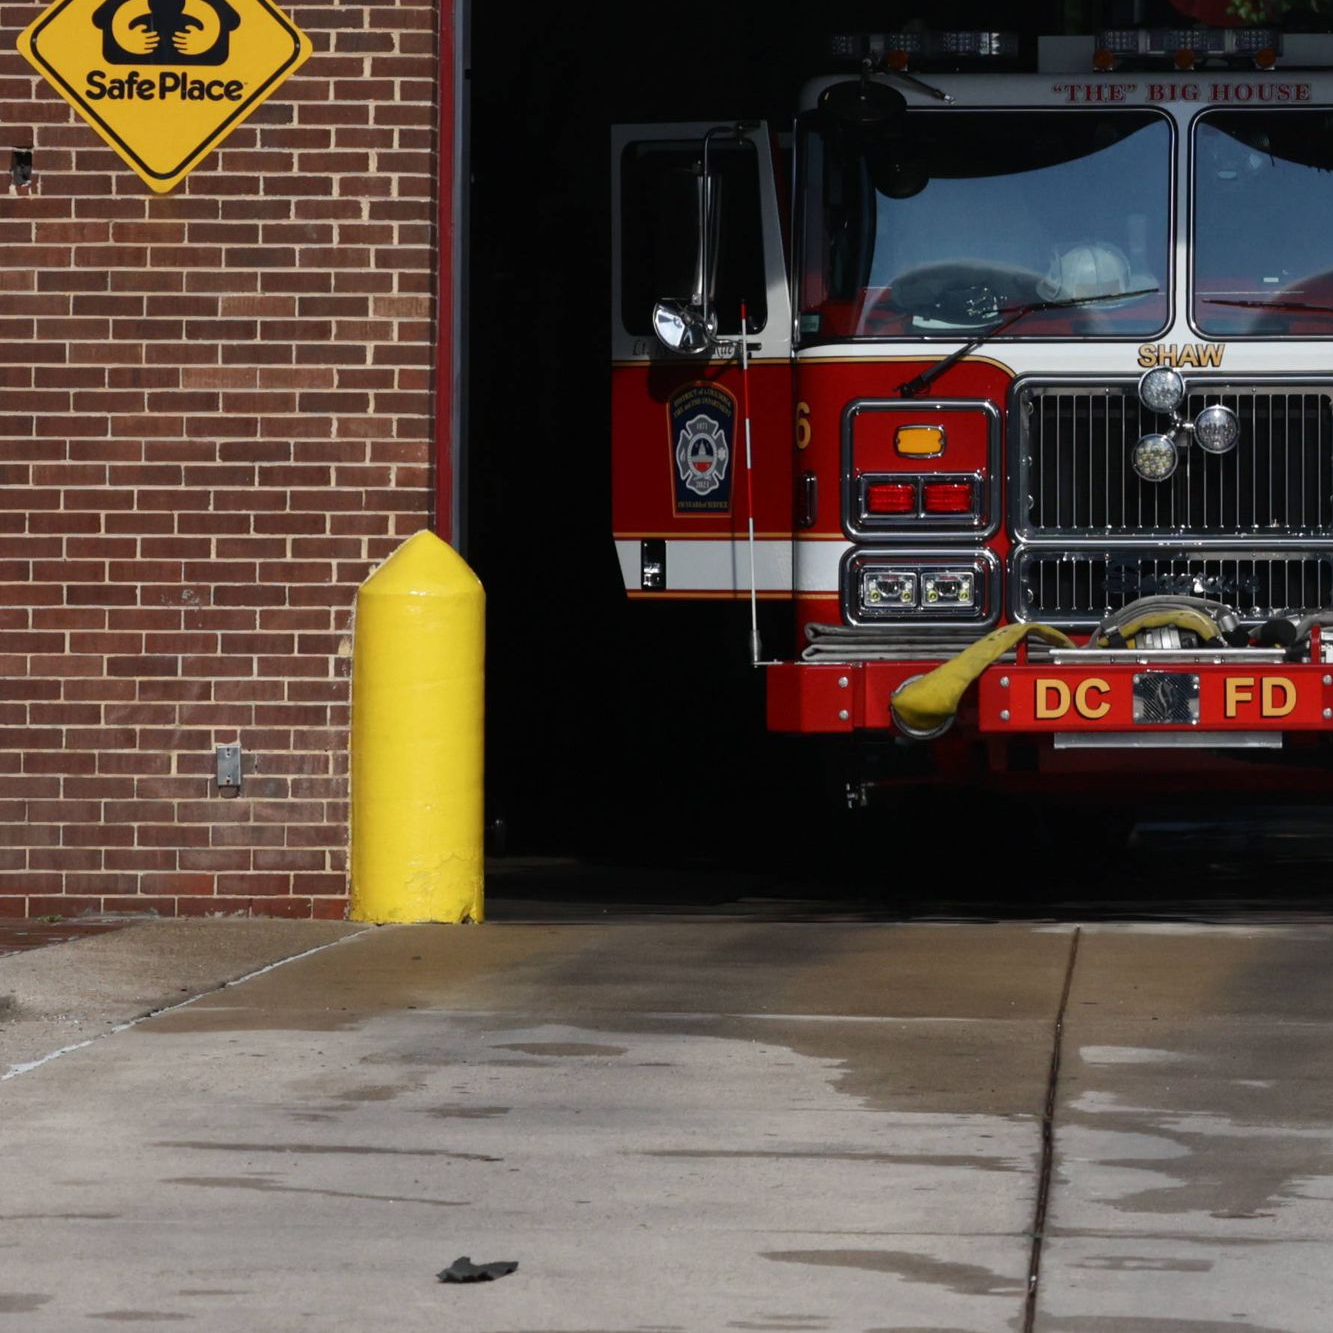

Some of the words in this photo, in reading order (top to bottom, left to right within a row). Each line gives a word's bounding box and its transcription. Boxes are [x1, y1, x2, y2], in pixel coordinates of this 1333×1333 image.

[85, 70, 156, 101] Safe
[158, 71, 244, 102] Place
[1147, 83, 1200, 103] BIG
[1208, 83, 1312, 104] HOUSE
[1137, 343, 1226, 367] SHAW
[795, 401, 812, 450] 6
[1036, 677, 1112, 719] DC
[1225, 676, 1298, 718] FD
